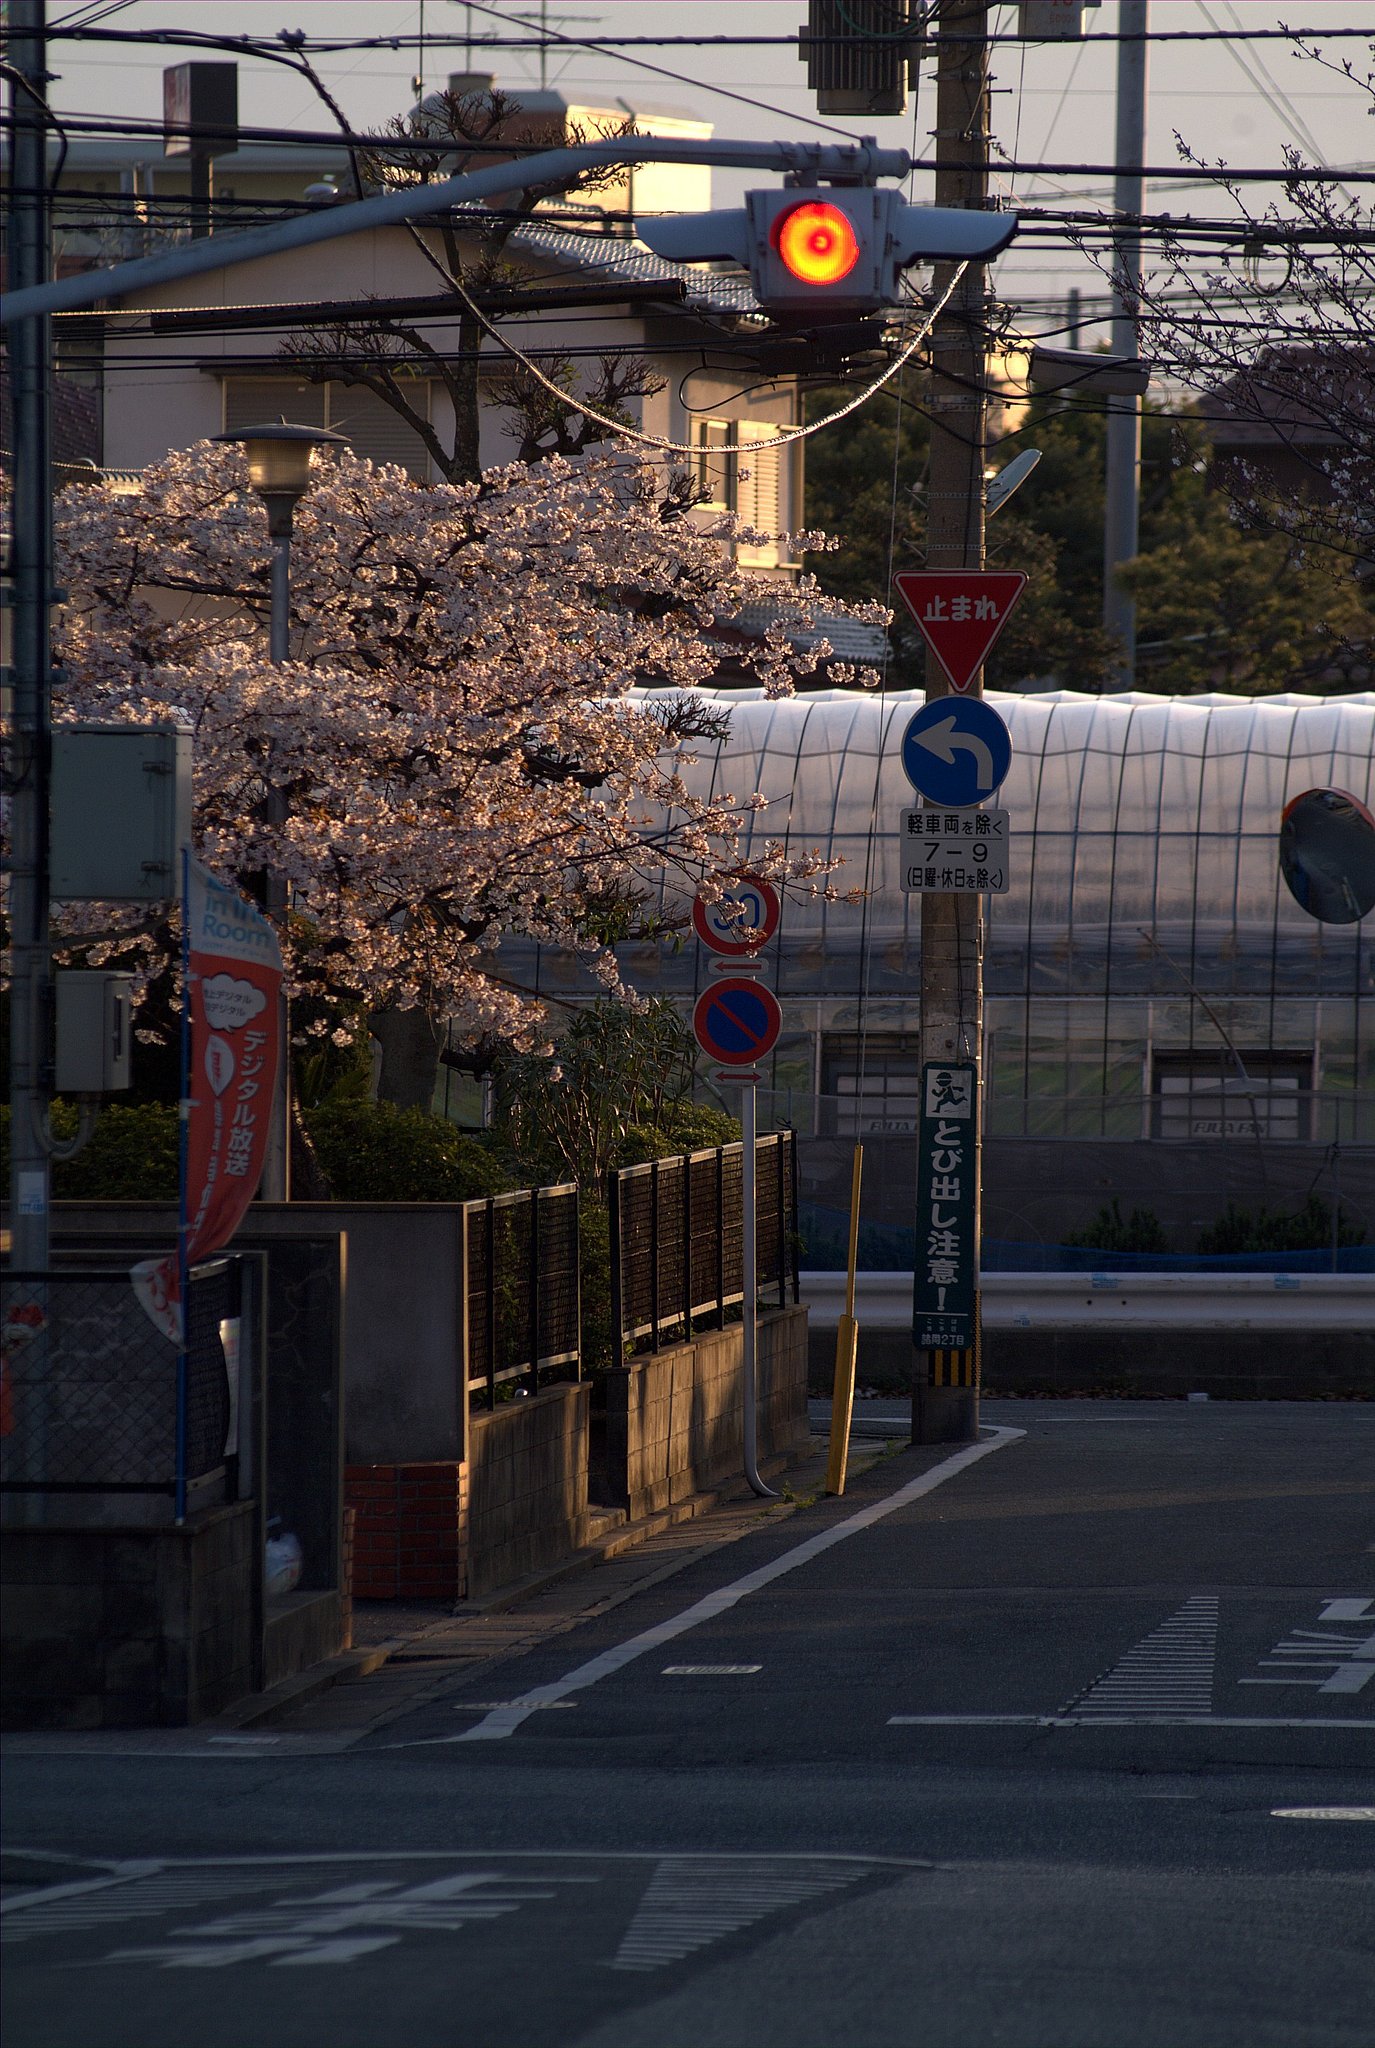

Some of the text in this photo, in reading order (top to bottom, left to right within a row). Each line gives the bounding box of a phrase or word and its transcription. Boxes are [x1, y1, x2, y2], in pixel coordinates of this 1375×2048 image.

[922, 594, 1000, 621] 止まれ
[907, 813, 1003, 835] 軽車両を除く
[906, 866, 1003, 889] (日曜・休日を除く)
[203, 914, 270, 948] Room
[223, 1029, 267, 1177] デジタル放送
[927, 1119, 964, 1312] とび出し注意!
